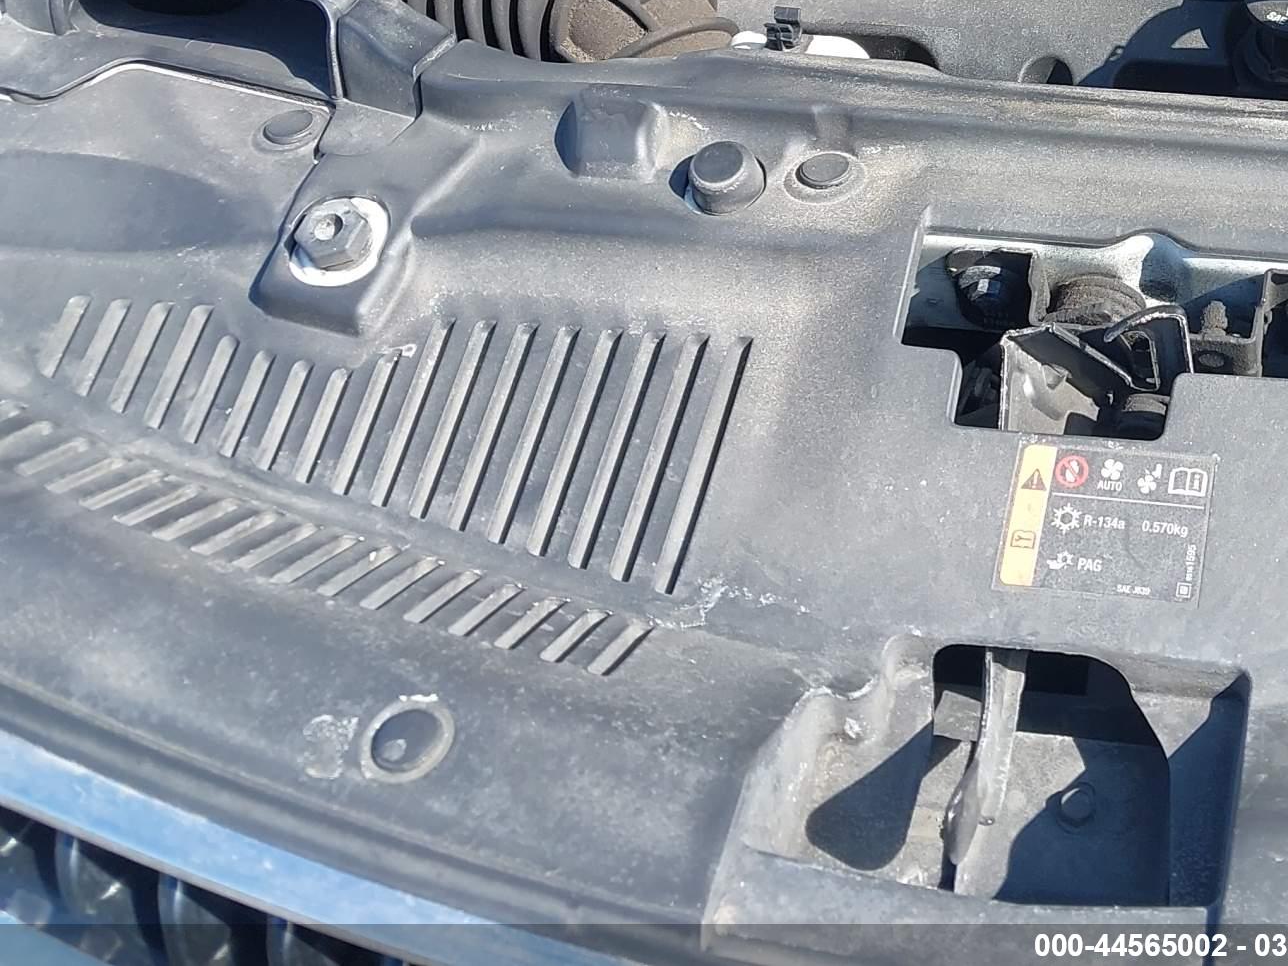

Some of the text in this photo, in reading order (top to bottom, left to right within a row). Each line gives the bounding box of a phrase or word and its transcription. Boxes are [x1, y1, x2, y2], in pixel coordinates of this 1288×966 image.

[1266, 12, 1288, 25] SAE
[1097, 480, 1123, 492] AUTO
[1083, 514, 1189, 538] R-134a 0.570kg
[1077, 557, 1102, 572] PAG
